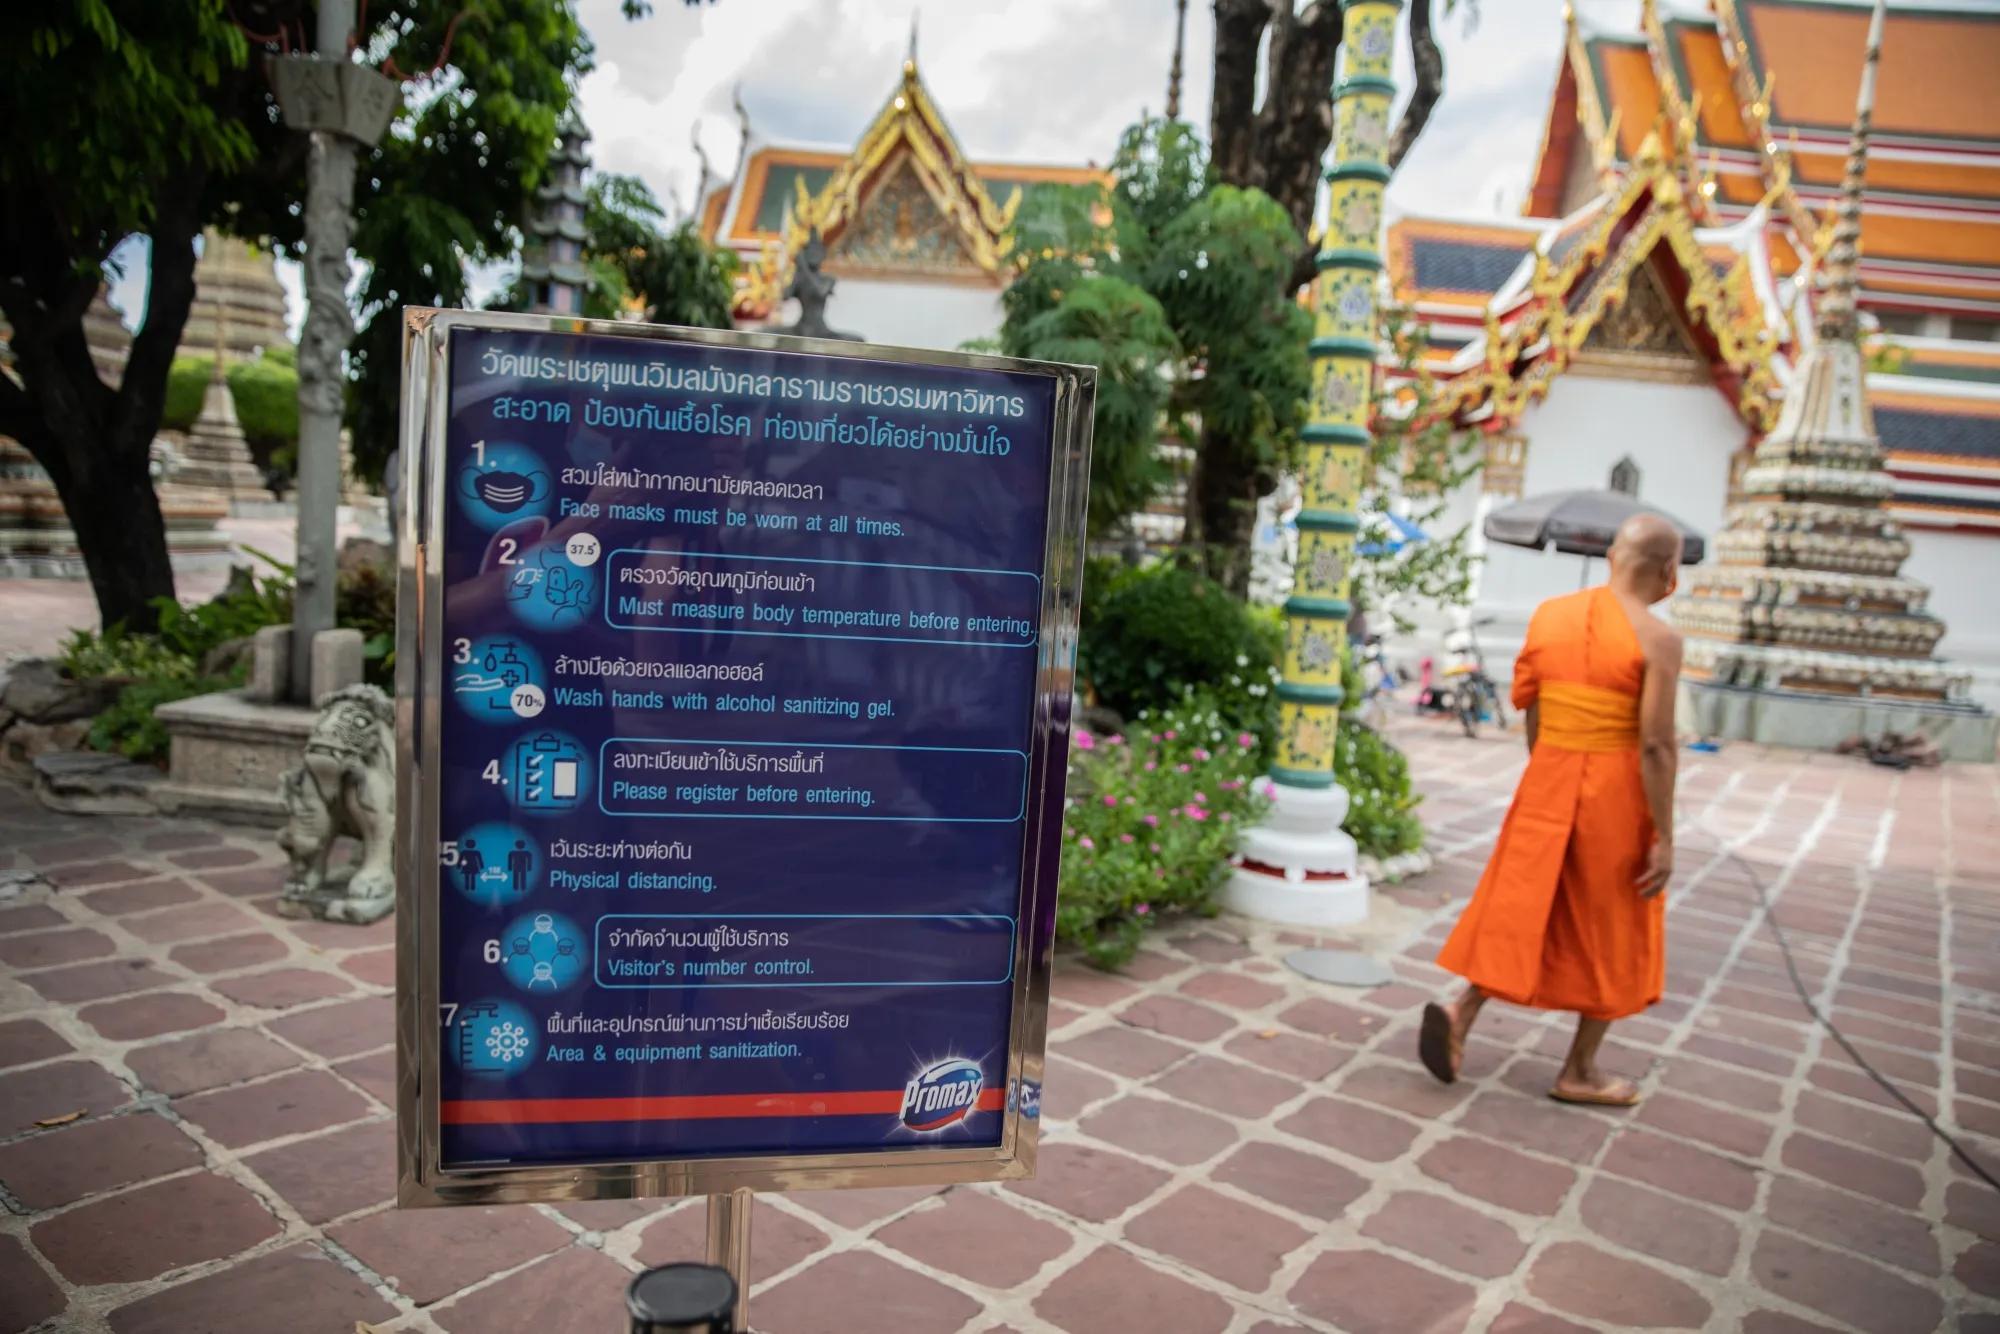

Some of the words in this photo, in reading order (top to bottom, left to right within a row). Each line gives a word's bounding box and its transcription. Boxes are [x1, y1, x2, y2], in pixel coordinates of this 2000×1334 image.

[481, 346, 1024, 417] วัดพระเชตุพนวิมลมังคลารามราชวรมหาวิหาร
[492, 396, 571, 424] สะอาด
[584, 398, 751, 437] ป้องกันเชื้อโรค
[764, 412, 1011, 456] ท่องเที่ยวได้อย่างมั่นใจ
[471, 440, 497, 467] 1.
[561, 462, 823, 500] สวมใส่หน้ากากอนามัยตลอดเวลา
[560, 498, 600, 518] Face
[608, 503, 666, 522] masks
[674, 507, 719, 525] must
[726, 508, 747, 527] be
[755, 513, 798, 530] worn
[806, 514, 822, 532] at
[829, 515, 848, 533] all
[856, 517, 905, 537] times.
[498, 538, 525, 565] 2.
[620, 565, 815, 595] ตรวจวัดอุณหภูมิก่อนเข้า
[619, 596, 664, 616] Must
[672, 602, 745, 620] measure
[753, 603, 795, 625] body
[802, 606, 901, 628] temperature
[908, 611, 960, 631] before
[967, 614, 1034, 637] entering.
[453, 638, 480, 665] 3.
[554, 654, 764, 682] ล้างมือด้วยเจลแอลกอฮอล์
[515, 694, 543, 708] 70%
[554, 687, 603, 707] Wash
[612, 689, 664, 709] hands
[672, 692, 708, 710] with
[715, 693, 776, 712] alcohol
[783, 697, 859, 719] sanitizing
[867, 700, 896, 720] gel.
[481, 759, 509, 786] 4.
[613, 748, 824, 773] ลงทะเบียนเข้าใช้บริการพื้นที่
[613, 781, 667, 801] Please
[676, 784, 739, 804] register
[747, 784, 799, 803] before
[806, 786, 876, 808] entering.
[441, 841, 468, 866] 5.
[550, 838, 692, 861] เว้นระยะห่างต่อกัน
[550, 870, 620, 892] Physical
[628, 871, 718, 893] distancing.
[483, 939, 509, 964] 6.
[608, 925, 789, 953] จำกัดจำนวนผู้ใช้บริการ
[608, 959, 675, 977] Visitor's
[683, 959, 748, 976] number
[754, 959, 815, 976] control.
[440, 1003, 467, 1027] 7.
[547, 1009, 849, 1038] พื้นที่และอุปกรณ์ผ่านการฆ่าเชื้อเรียบร้อย
[546, 1046, 585, 1062] Area
[593, 1045, 607, 1062] &
[615, 1043, 702, 1064] equipment
[709, 1041, 802, 1060] sanitization.
[899, 1078, 983, 1120] Promax
